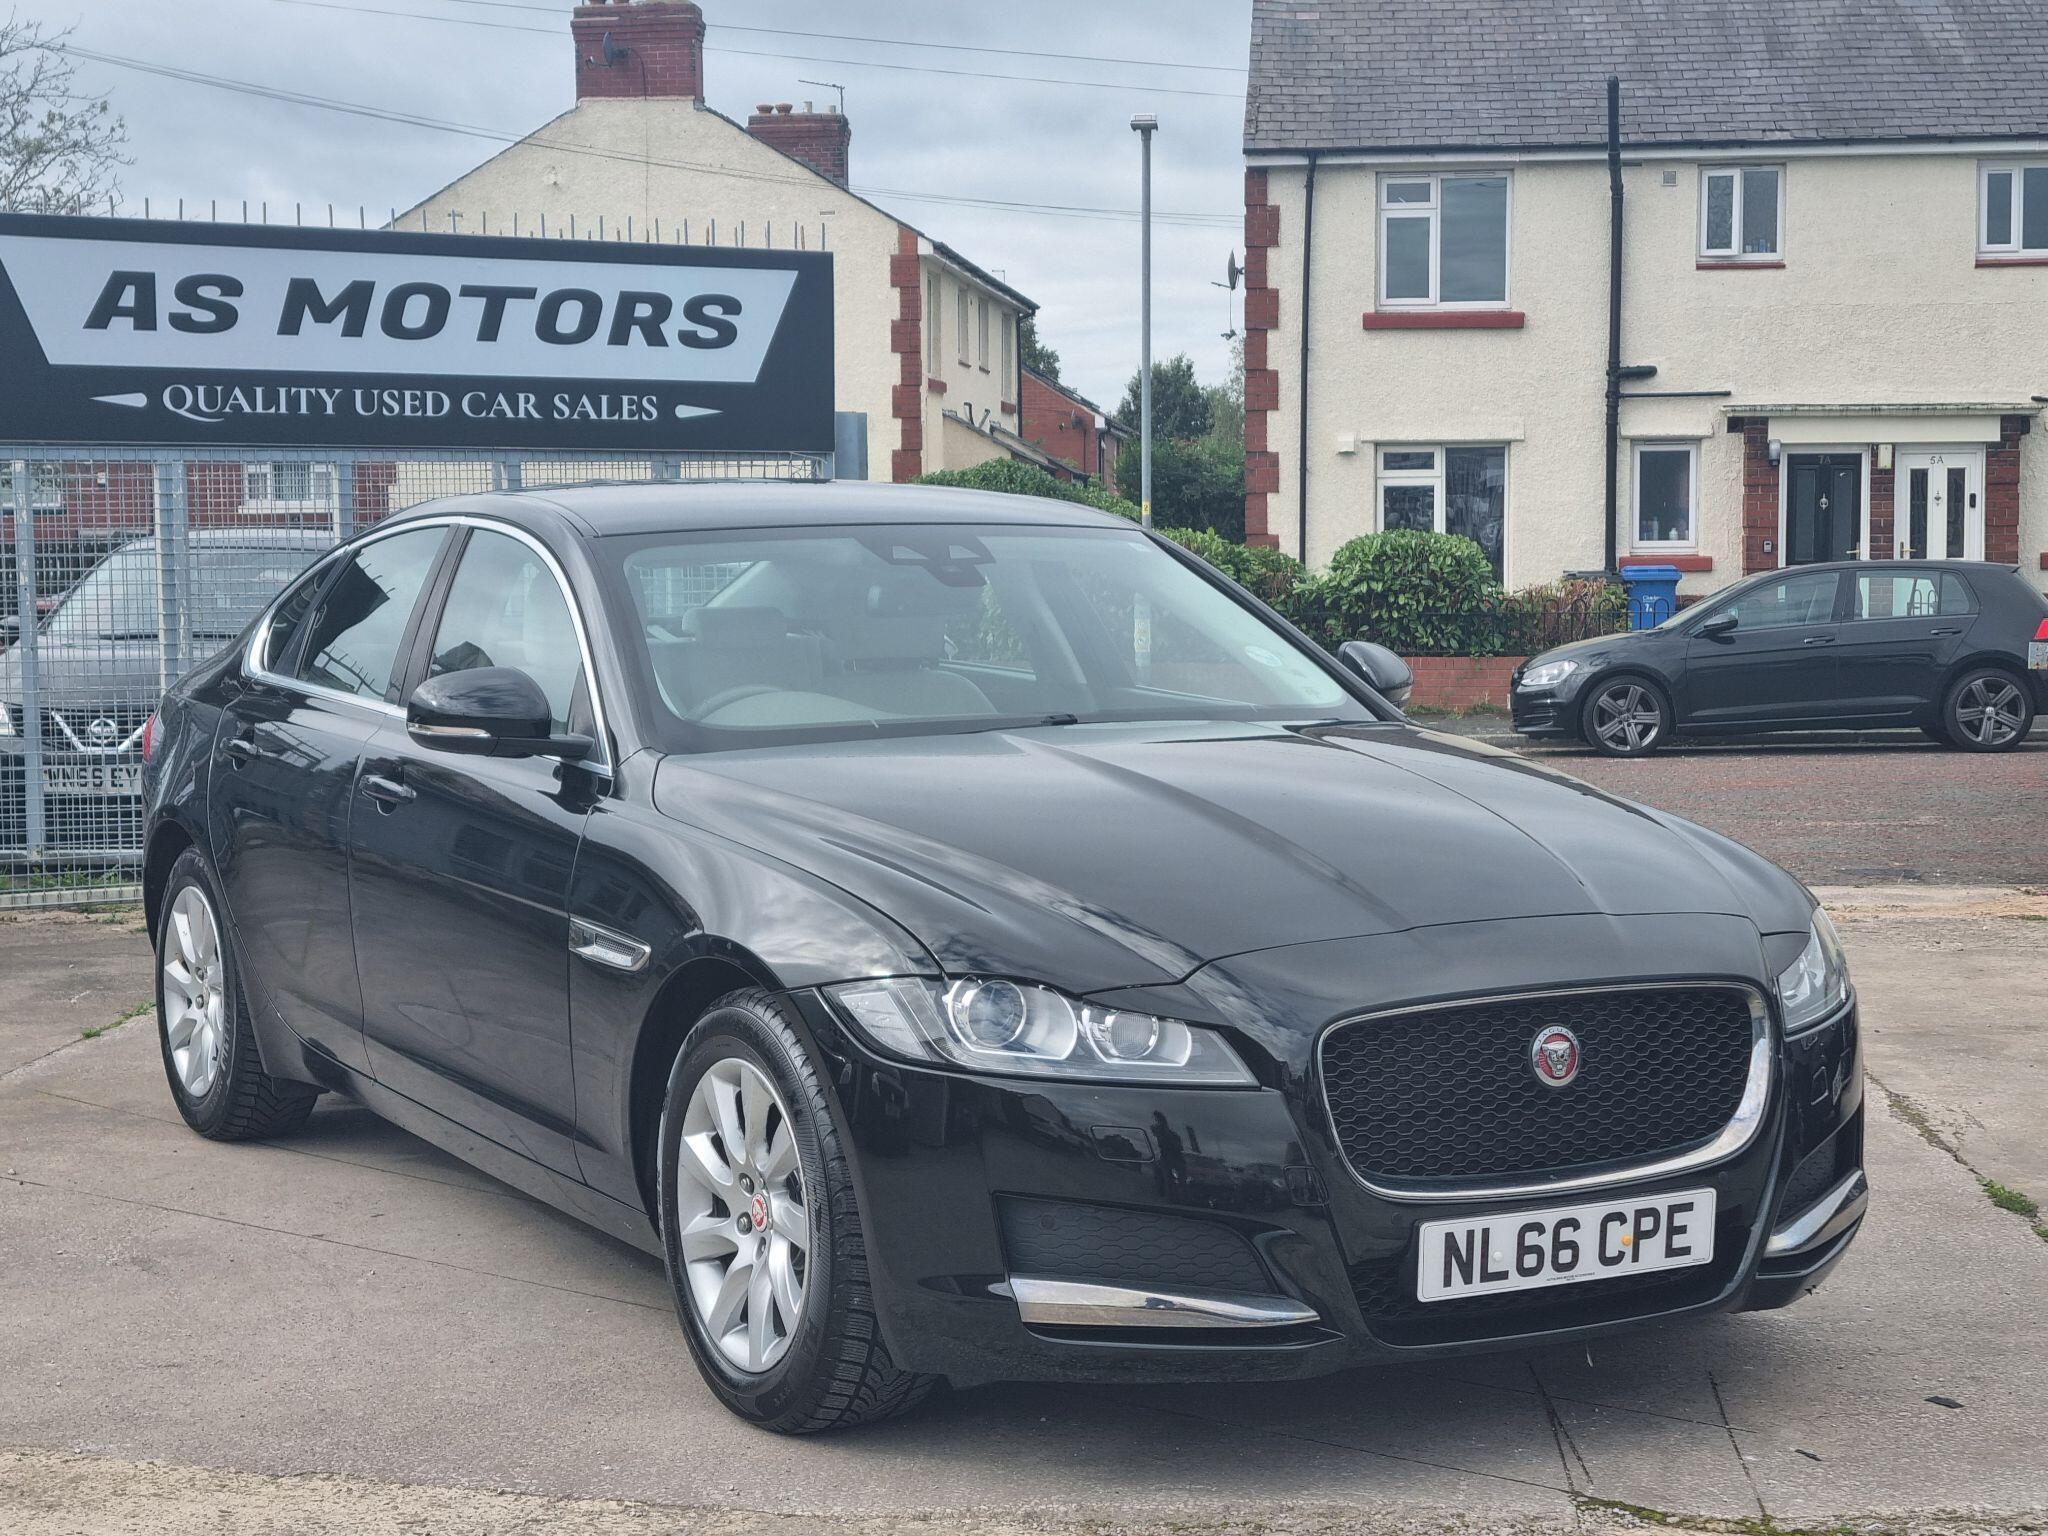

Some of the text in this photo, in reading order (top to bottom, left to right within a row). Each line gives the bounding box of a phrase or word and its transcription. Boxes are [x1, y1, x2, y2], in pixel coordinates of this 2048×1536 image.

[82, 270, 743, 350] AS MOTORS
[162, 384, 658, 422] QUALITY USED CAR SALES
[1818, 455, 1831, 464] 7A
[1930, 456, 1944, 465] 5A
[111, 767, 139, 787] EY
[1443, 1202, 1694, 1288] NL66 CPE
